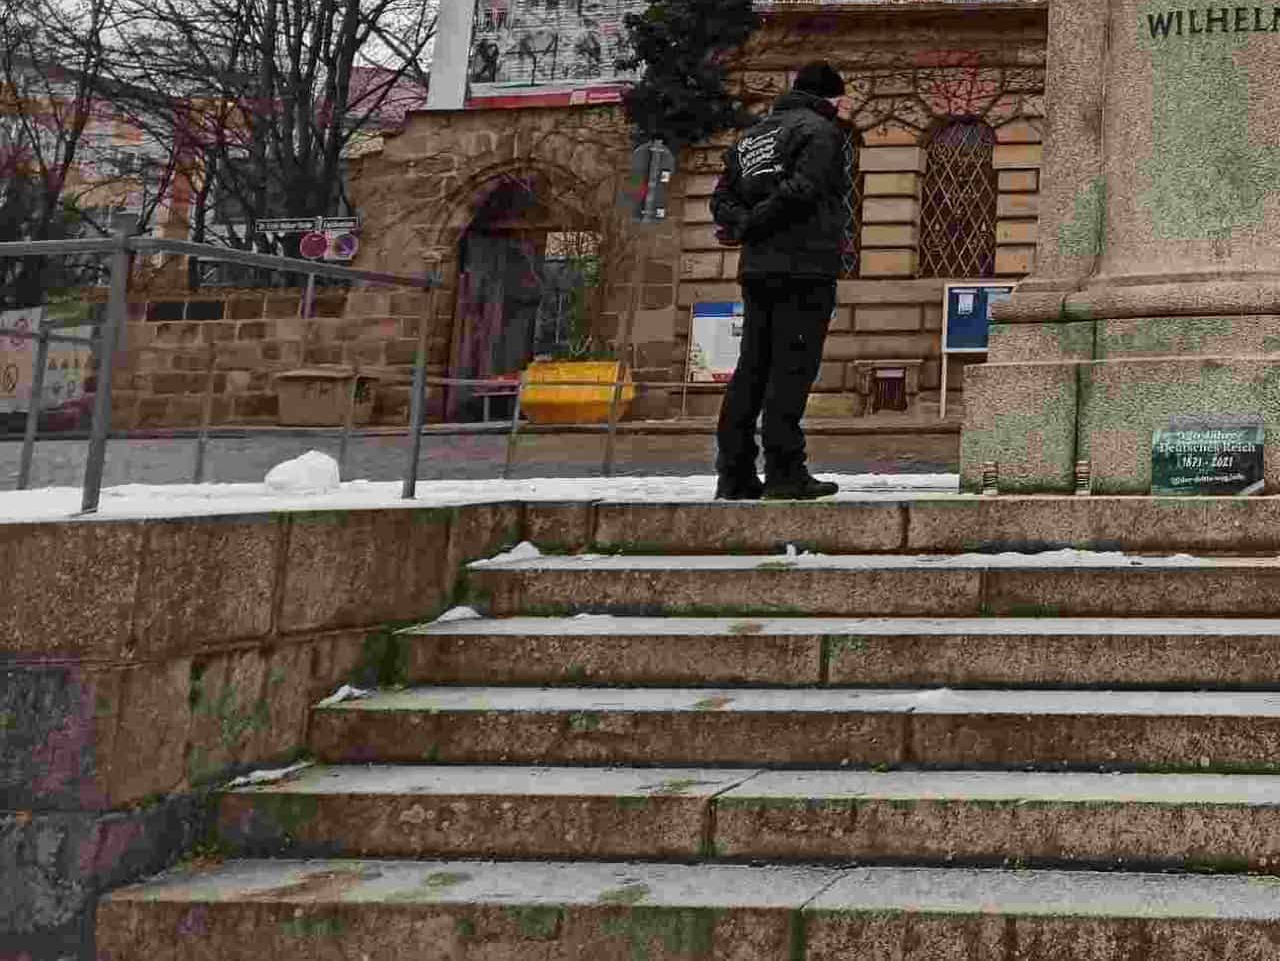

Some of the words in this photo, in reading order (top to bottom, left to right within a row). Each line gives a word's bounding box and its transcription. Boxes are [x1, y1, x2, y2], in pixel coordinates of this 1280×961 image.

[1160, 441, 1219, 455] Deutsches
[1223, 441, 1256, 453] Reich
[1183, 456, 1202, 468] 1871
[1211, 456, 1233, 468] 2021
